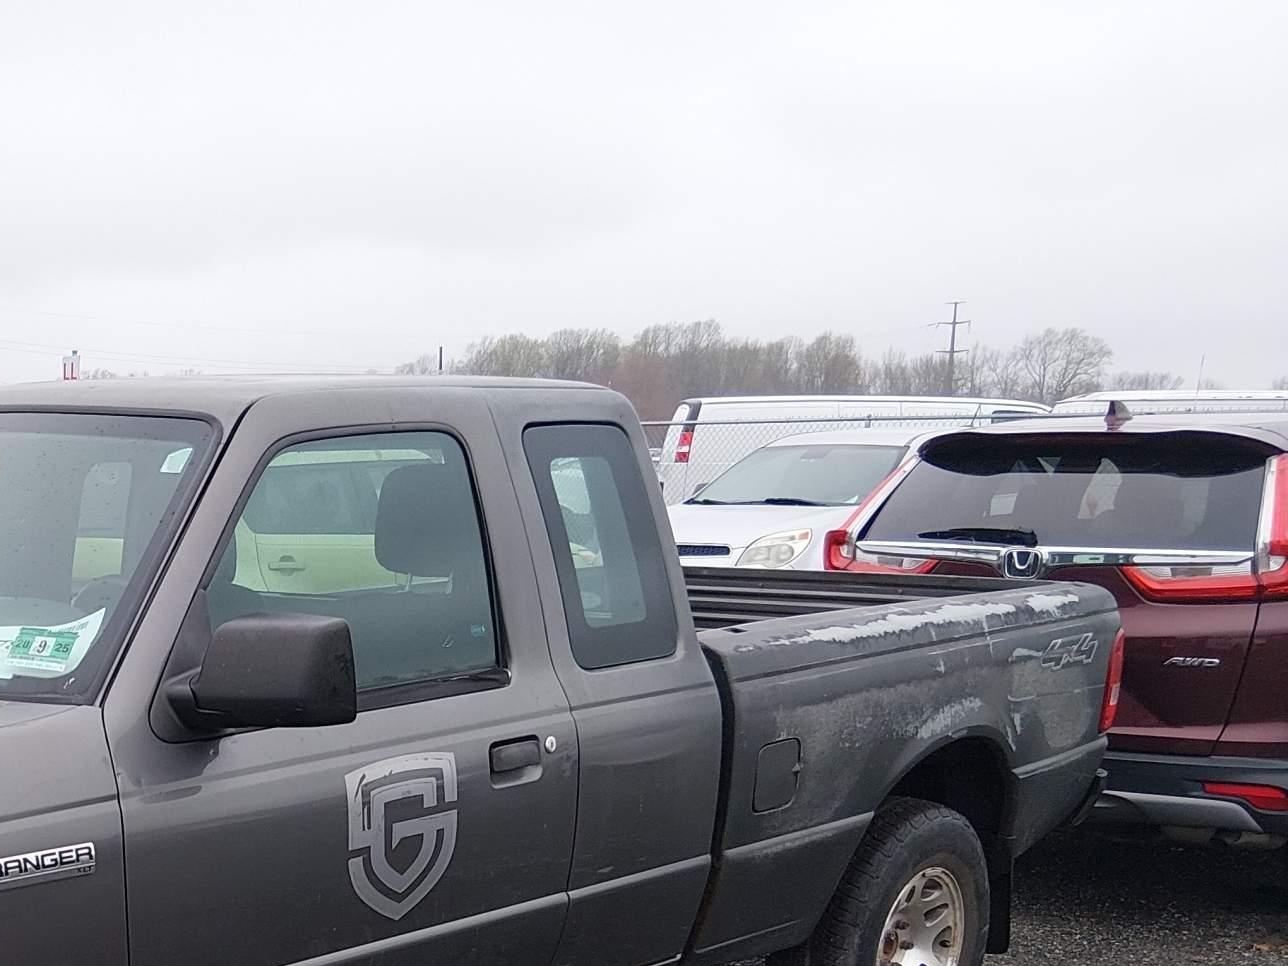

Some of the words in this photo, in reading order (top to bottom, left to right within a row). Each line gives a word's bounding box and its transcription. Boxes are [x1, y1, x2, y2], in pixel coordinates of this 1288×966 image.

[37, 640, 47, 653] 9
[55, 643, 71, 653] 25
[1163, 656, 1220, 667] AWD
